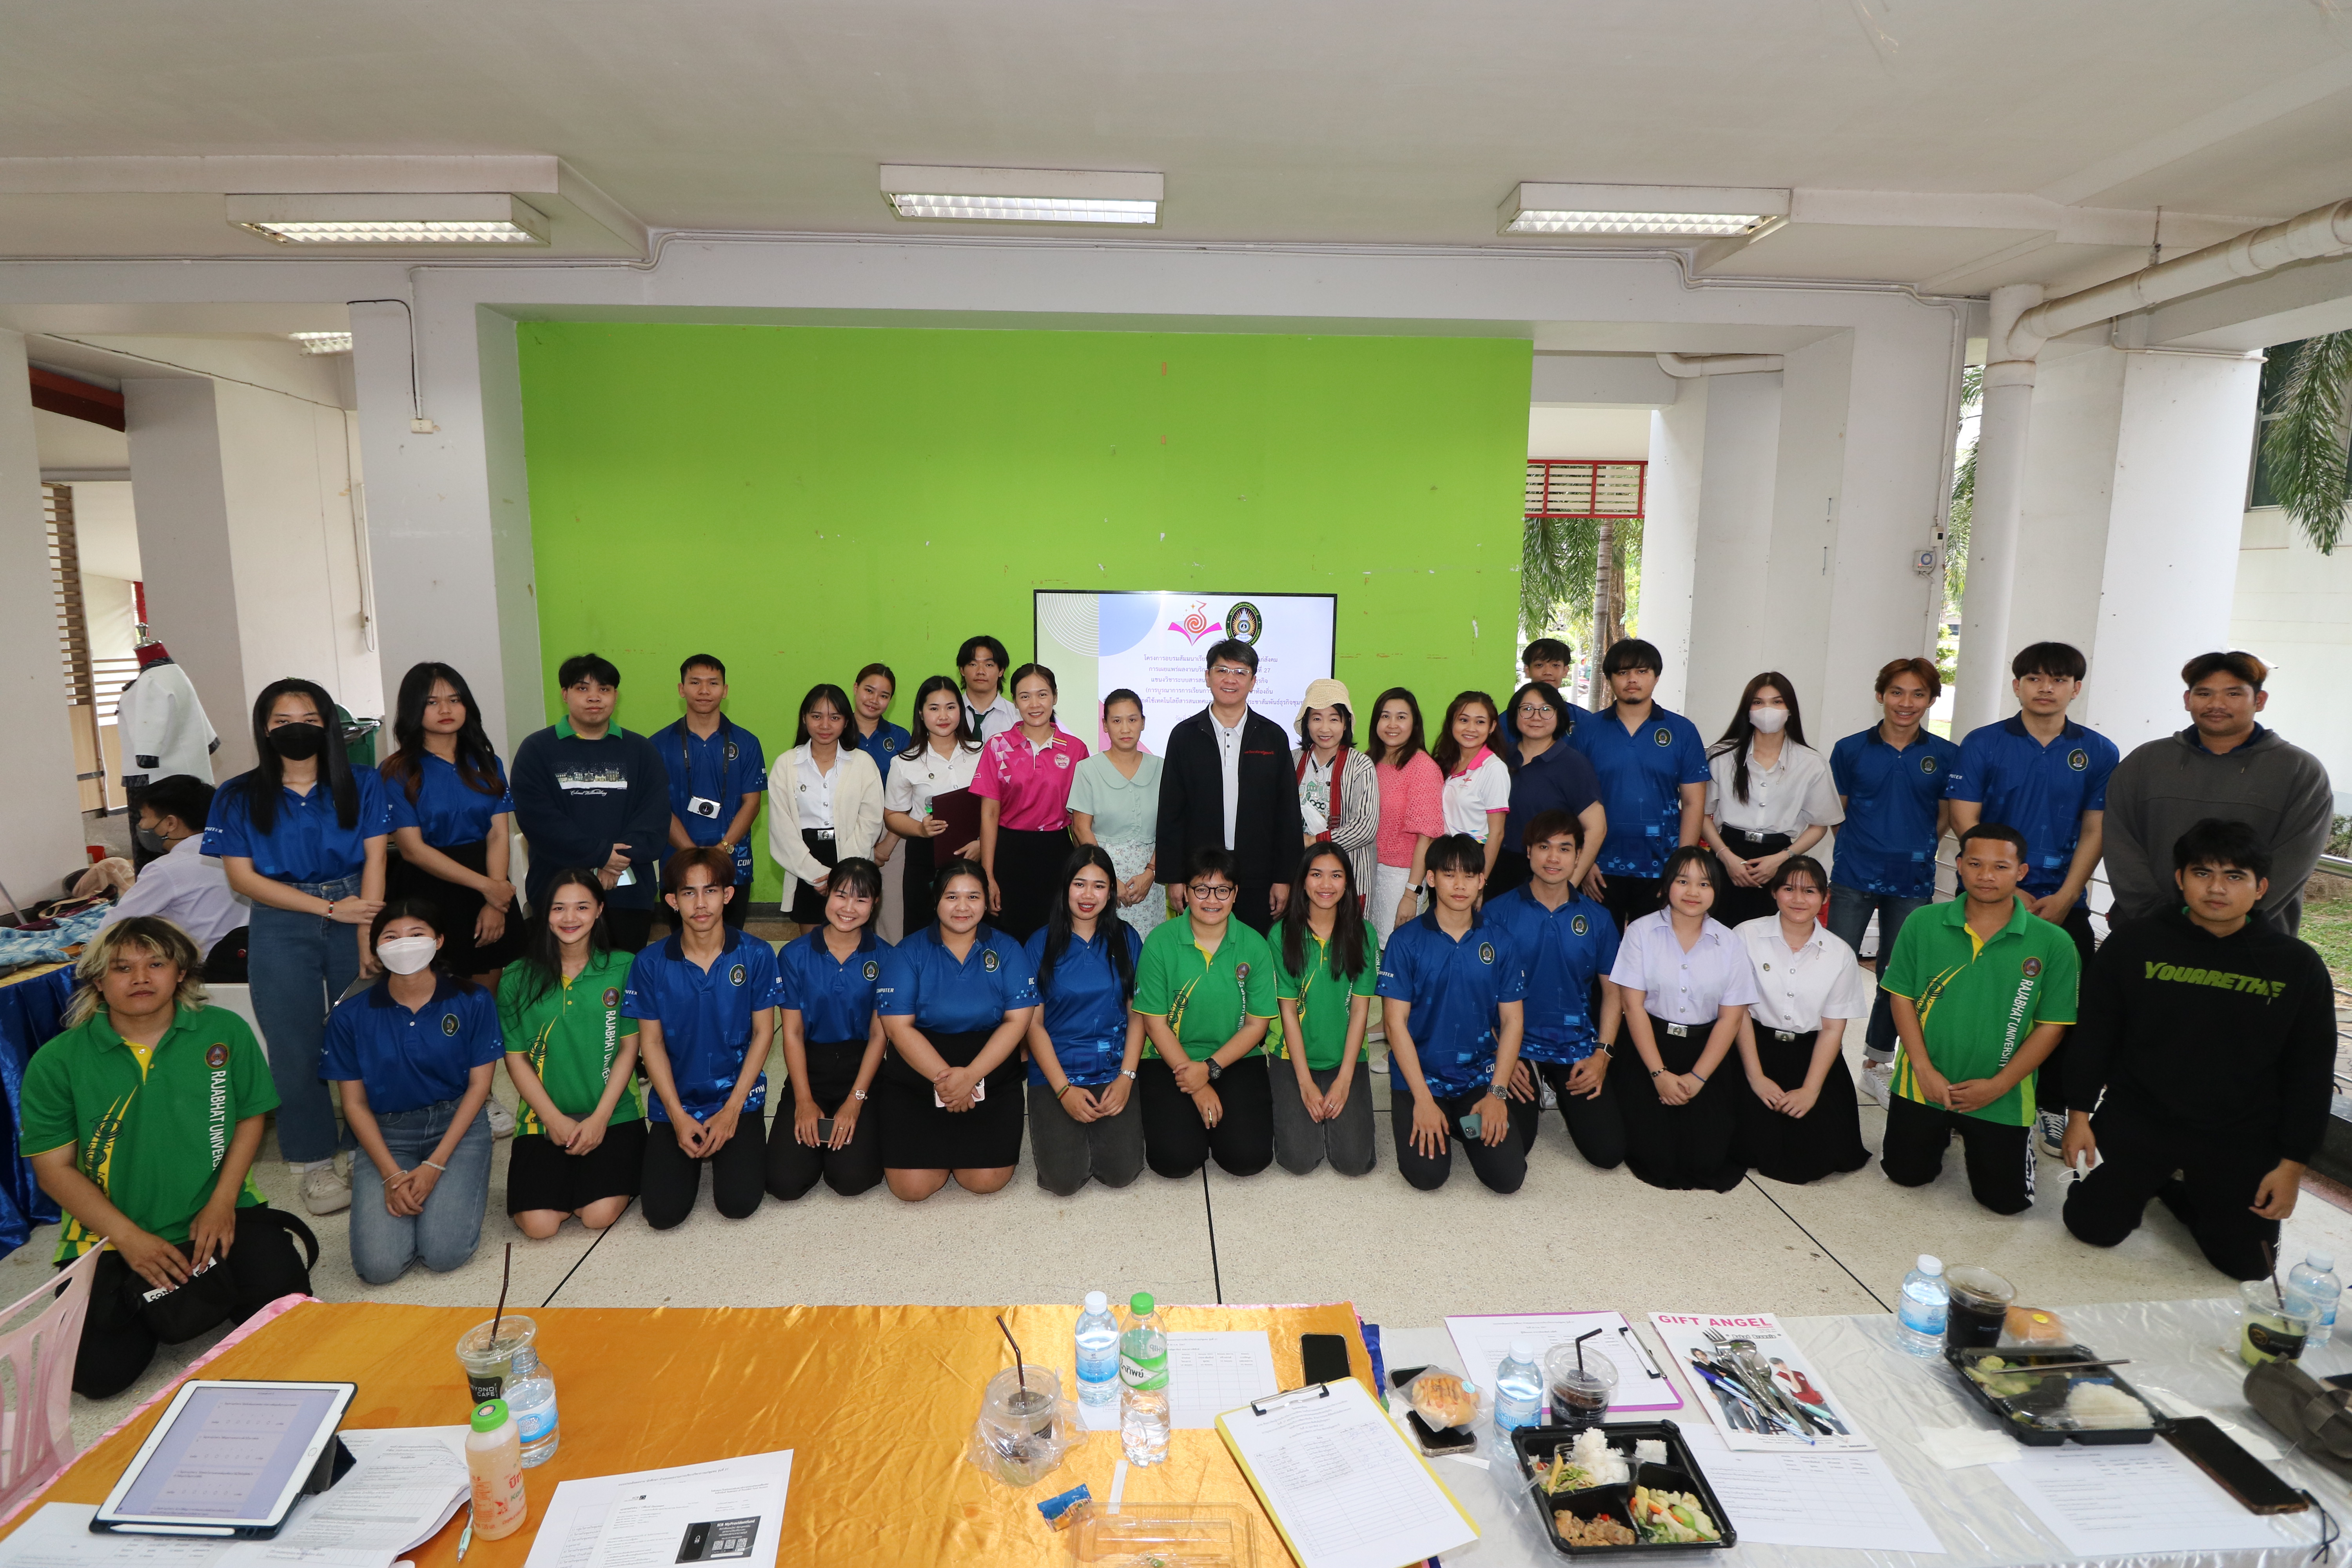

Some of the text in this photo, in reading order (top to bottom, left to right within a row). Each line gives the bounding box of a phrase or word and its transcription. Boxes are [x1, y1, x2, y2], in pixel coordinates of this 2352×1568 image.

[2009, 978, 2034, 1023] RAJABHAT
[605, 1010, 616, 1051] RAJABHAT
[209, 1070, 226, 1122] RAJABHAT
[1658, 1315, 1772, 1327] GIFT ANGEL
[522, 1423, 540, 1433] Drop
